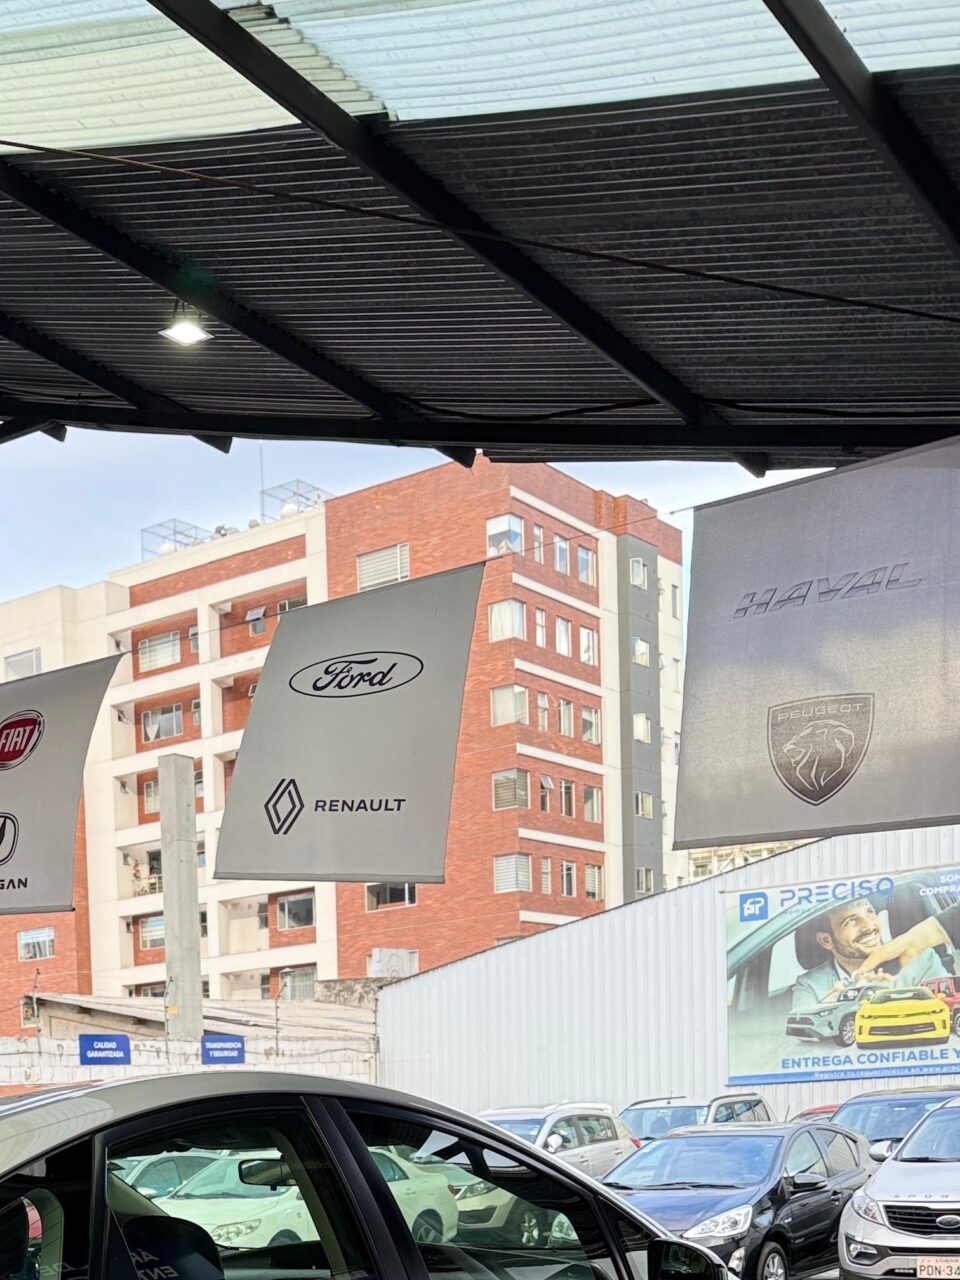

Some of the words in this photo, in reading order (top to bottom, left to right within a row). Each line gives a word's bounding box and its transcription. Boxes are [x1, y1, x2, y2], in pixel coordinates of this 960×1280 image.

[733, 562, 923, 619] HAVAL
[312, 657, 398, 692] Ford
[777, 702, 864, 722] PEUGEOT
[314, 798, 407, 812] RENAULT
[780, 876, 895, 908] PRECISO
[86, 1050, 124, 1059] GARANTIZADA
[93, 1041, 117, 1050] CALIDAD
[781, 1055, 853, 1069] ENTREGA
[857, 1049, 949, 1065] CONFIABLE
